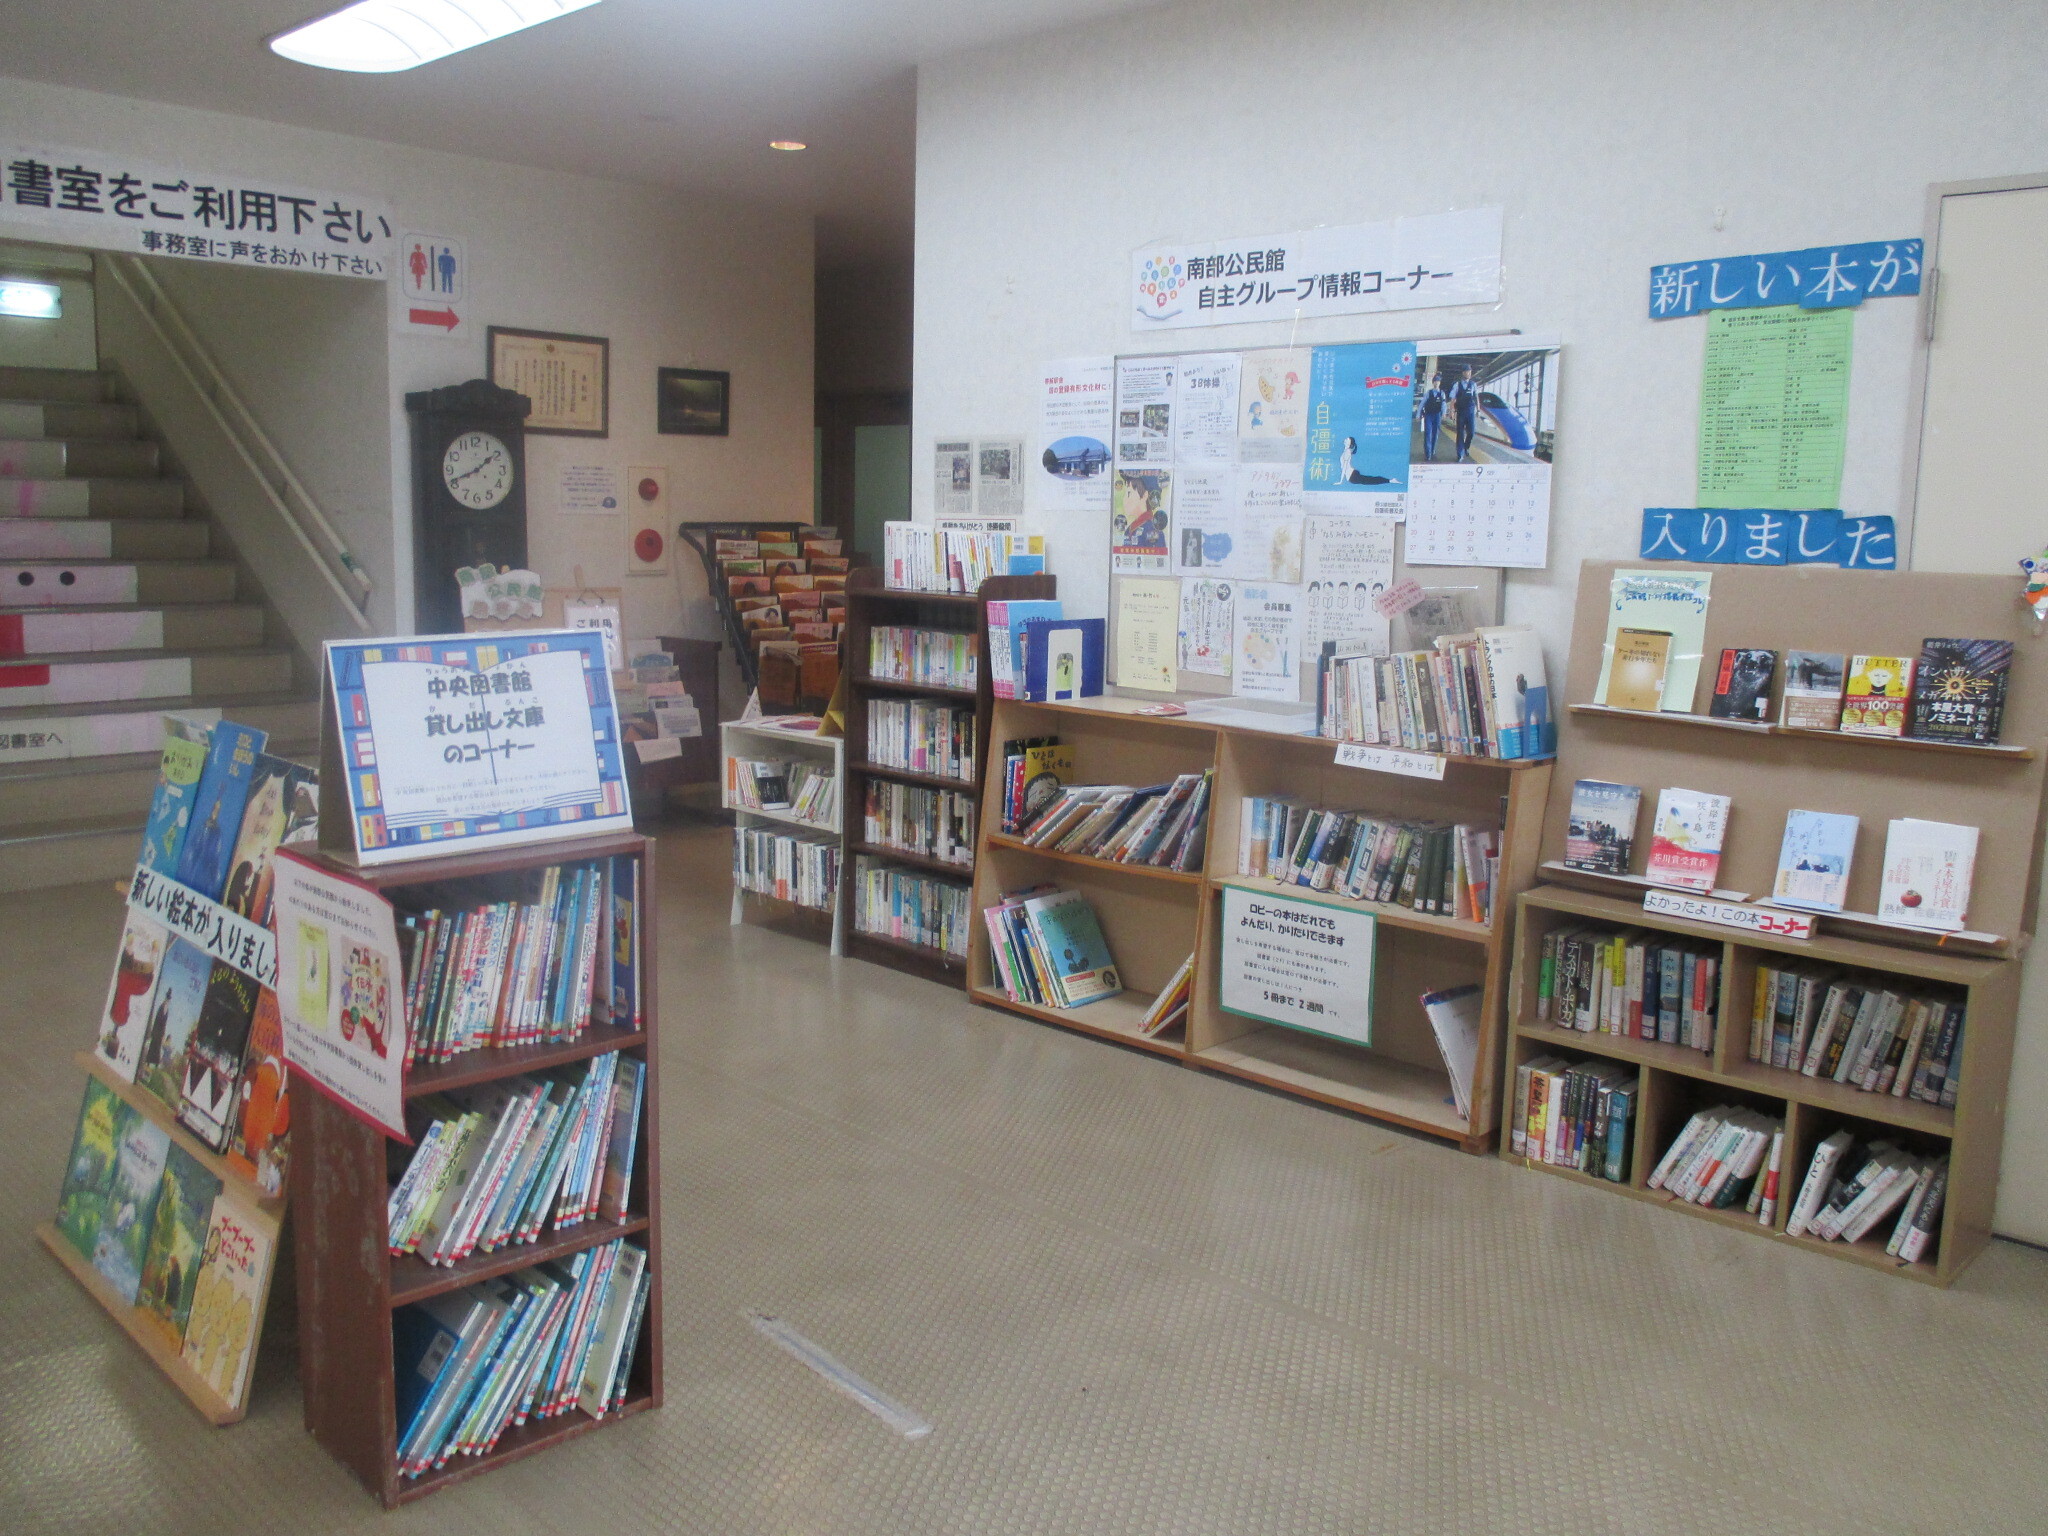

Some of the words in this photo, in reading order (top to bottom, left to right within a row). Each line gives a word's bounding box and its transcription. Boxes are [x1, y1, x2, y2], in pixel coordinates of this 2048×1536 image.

[0, 159, 392, 245] 書室をご利用下さい
[141, 230, 383, 276] 事務室に声をおかけ下さい
[1186, 249, 1285, 281] 南部公民館
[1198, 264, 1454, 309] 自主グループ情報コーナー
[1652, 243, 1920, 315] 新しい本が
[470, 436, 481, 448] 12
[445, 464, 454, 476] 9
[498, 465, 507, 477] 3
[1475, 466, 1484, 478] 9
[495, 479, 503, 489] 4
[462, 488, 471, 500] 7
[472, 493, 482, 504] 6
[485, 490, 494, 501] 5
[1642, 512, 1894, 566] 入りました
[1263, 602, 1292, 612] 会員募集
[1855, 657, 1908, 667] BUTTER
[428, 670, 533, 699] 中央図書館
[1931, 702, 1975, 714] 本屋大賞
[425, 706, 545, 737] 貸し出し文庫
[1928, 713, 1974, 725] ノミネート
[443, 741, 536, 764] のコーナー
[1342, 747, 1382, 764] 戦争とは
[1391, 754, 1434, 773] 平和とは
[1706, 798, 1721, 839] 彼岸花が
[1653, 853, 1708, 867] 芥川賞受賞作
[1250, 903, 1336, 930] ロビーの本はだれでも
[1644, 895, 1760, 926] よかったよ！この本
[1758, 914, 1809, 936] コーナー
[1299, 1000, 1324, 1015] 2週間
